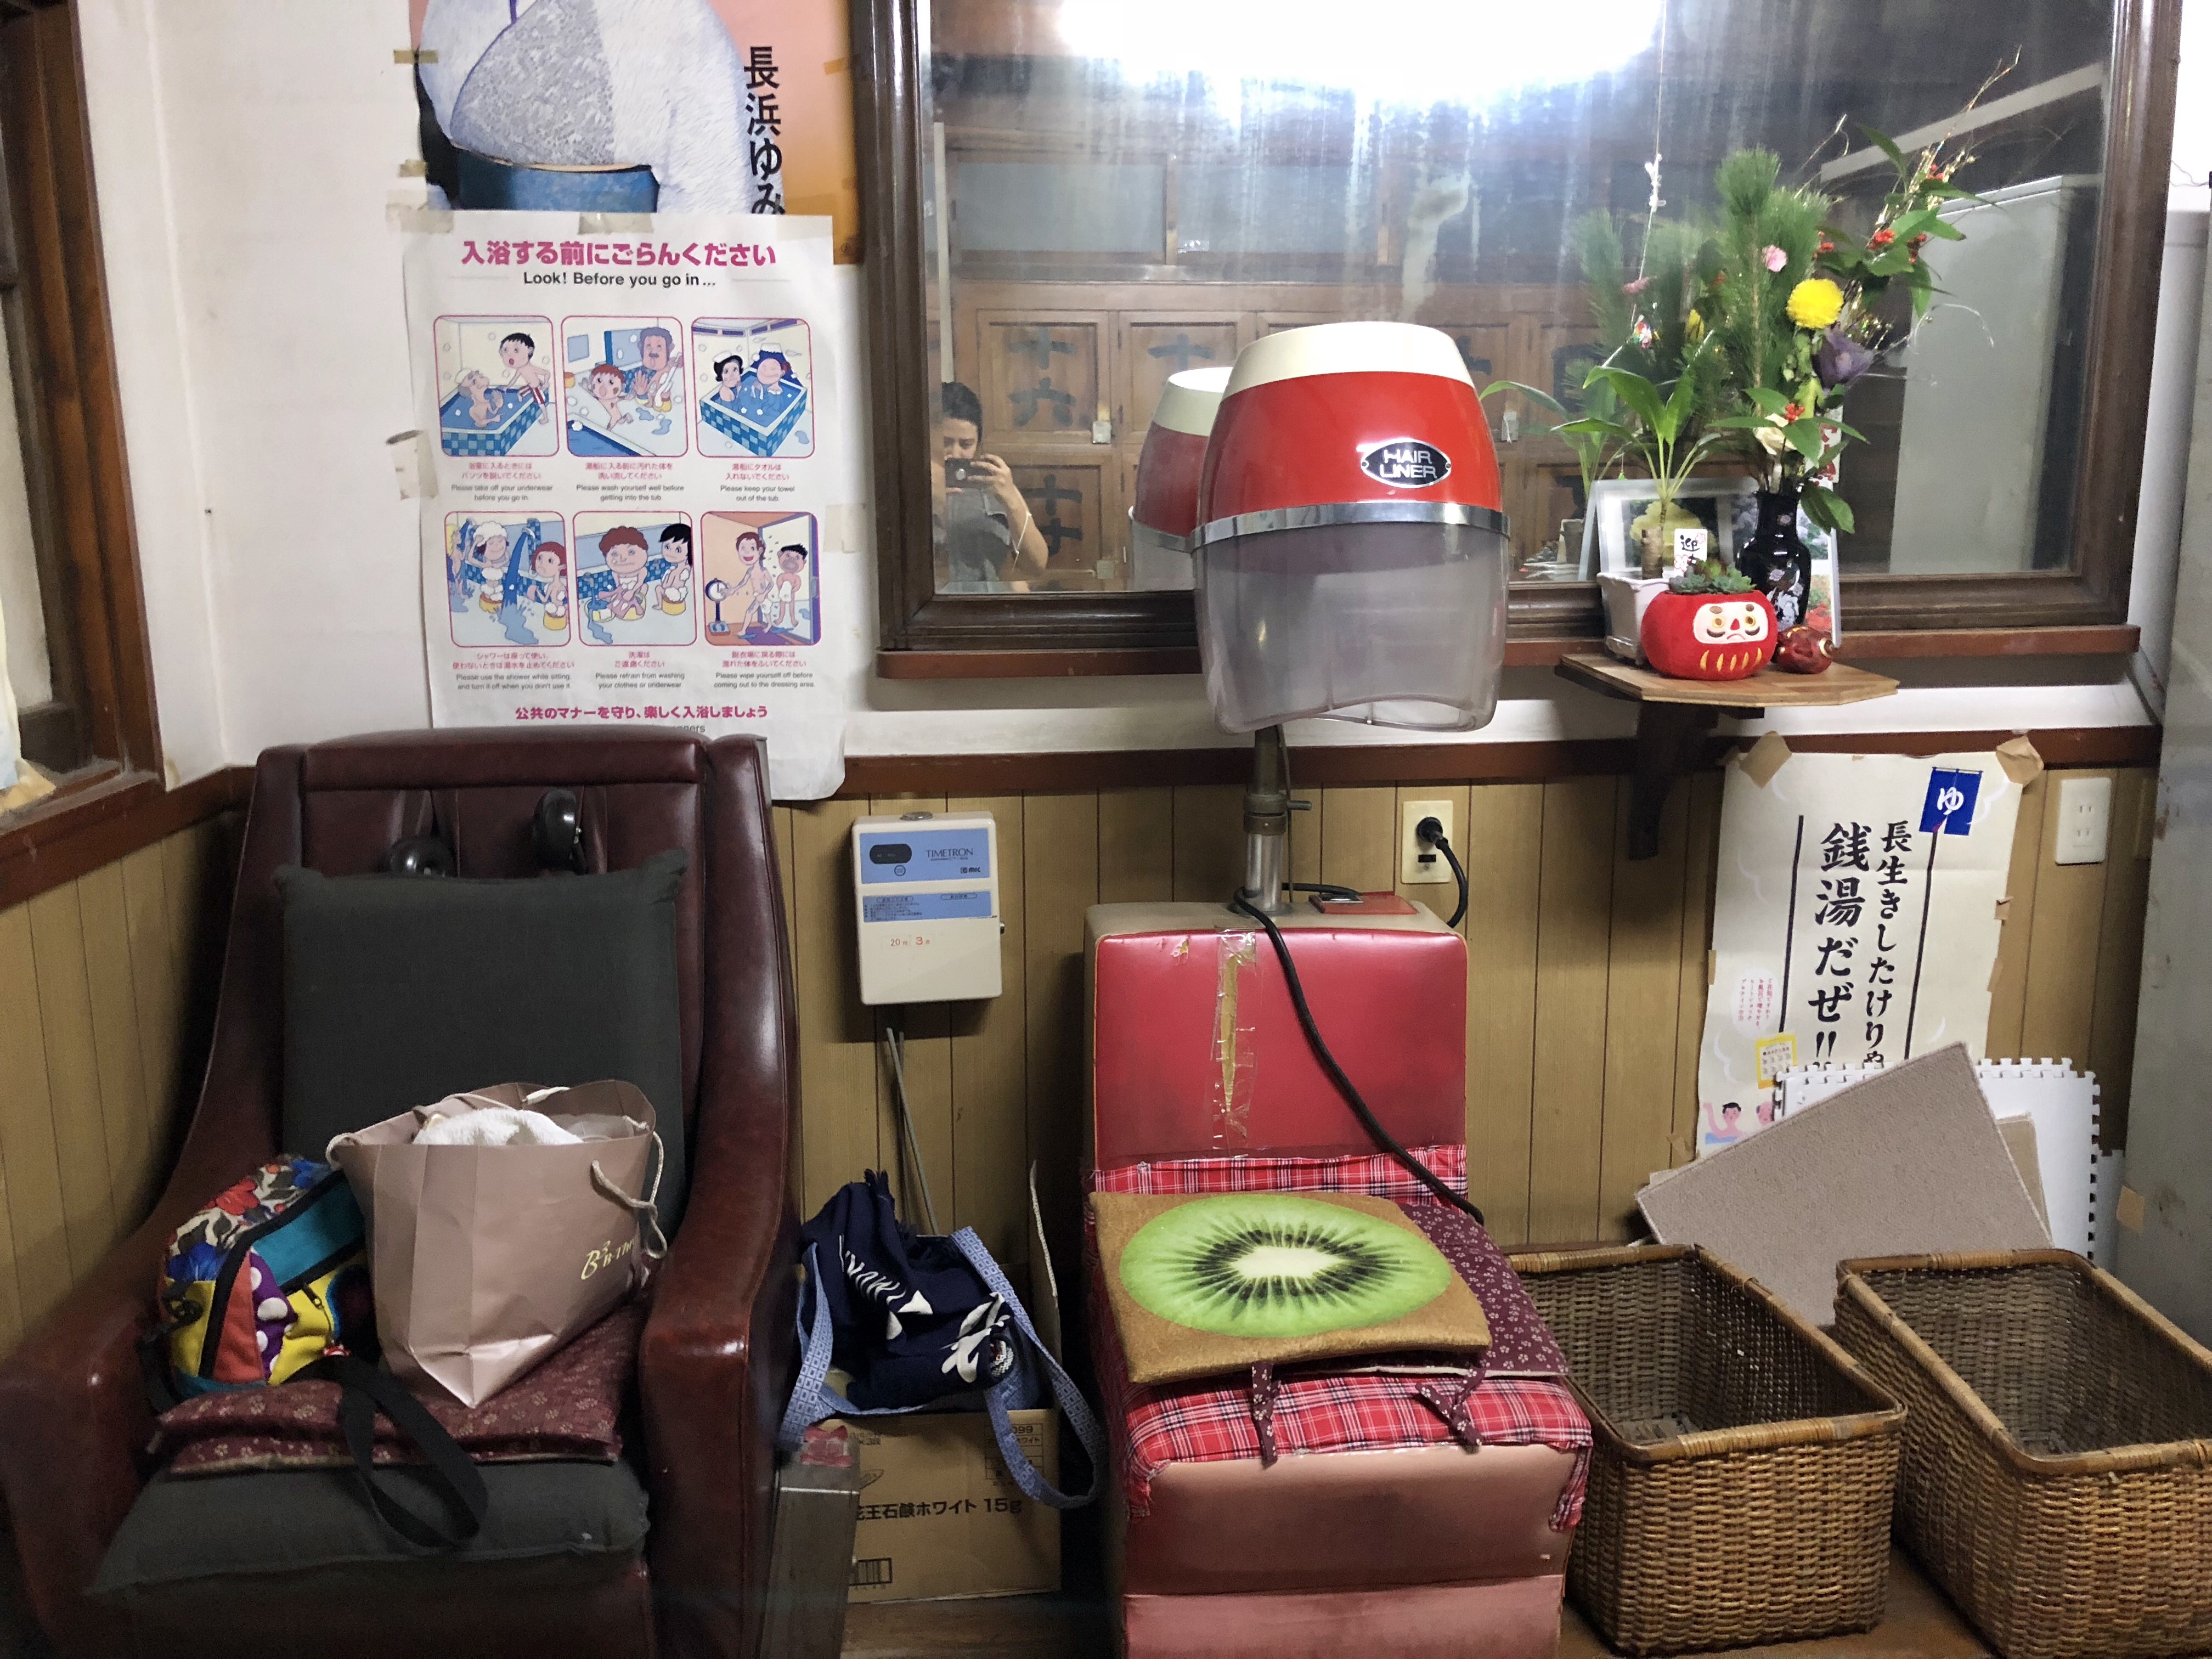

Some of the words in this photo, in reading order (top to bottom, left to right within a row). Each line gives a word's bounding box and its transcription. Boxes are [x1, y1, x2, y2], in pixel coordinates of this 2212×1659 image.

[744, 46, 785, 215] 長浜ゆみ
[461, 240, 776, 266] 入浴する前にごらんください
[523, 272, 566, 285] Look!
[573, 273, 624, 286] Before
[630, 276, 657, 289] you
[662, 276, 681, 289] go
[1384, 449, 1432, 464] HAIR
[1380, 464, 1437, 478] LINER
[620, 484, 646, 493] yourself
[744, 485, 760, 493] keep
[515, 706, 768, 719] 公共のマナーを守り、楽しく入浴しましょう
[1936, 786, 1964, 816] ゆ
[926, 848, 974, 857] TIMETRON
